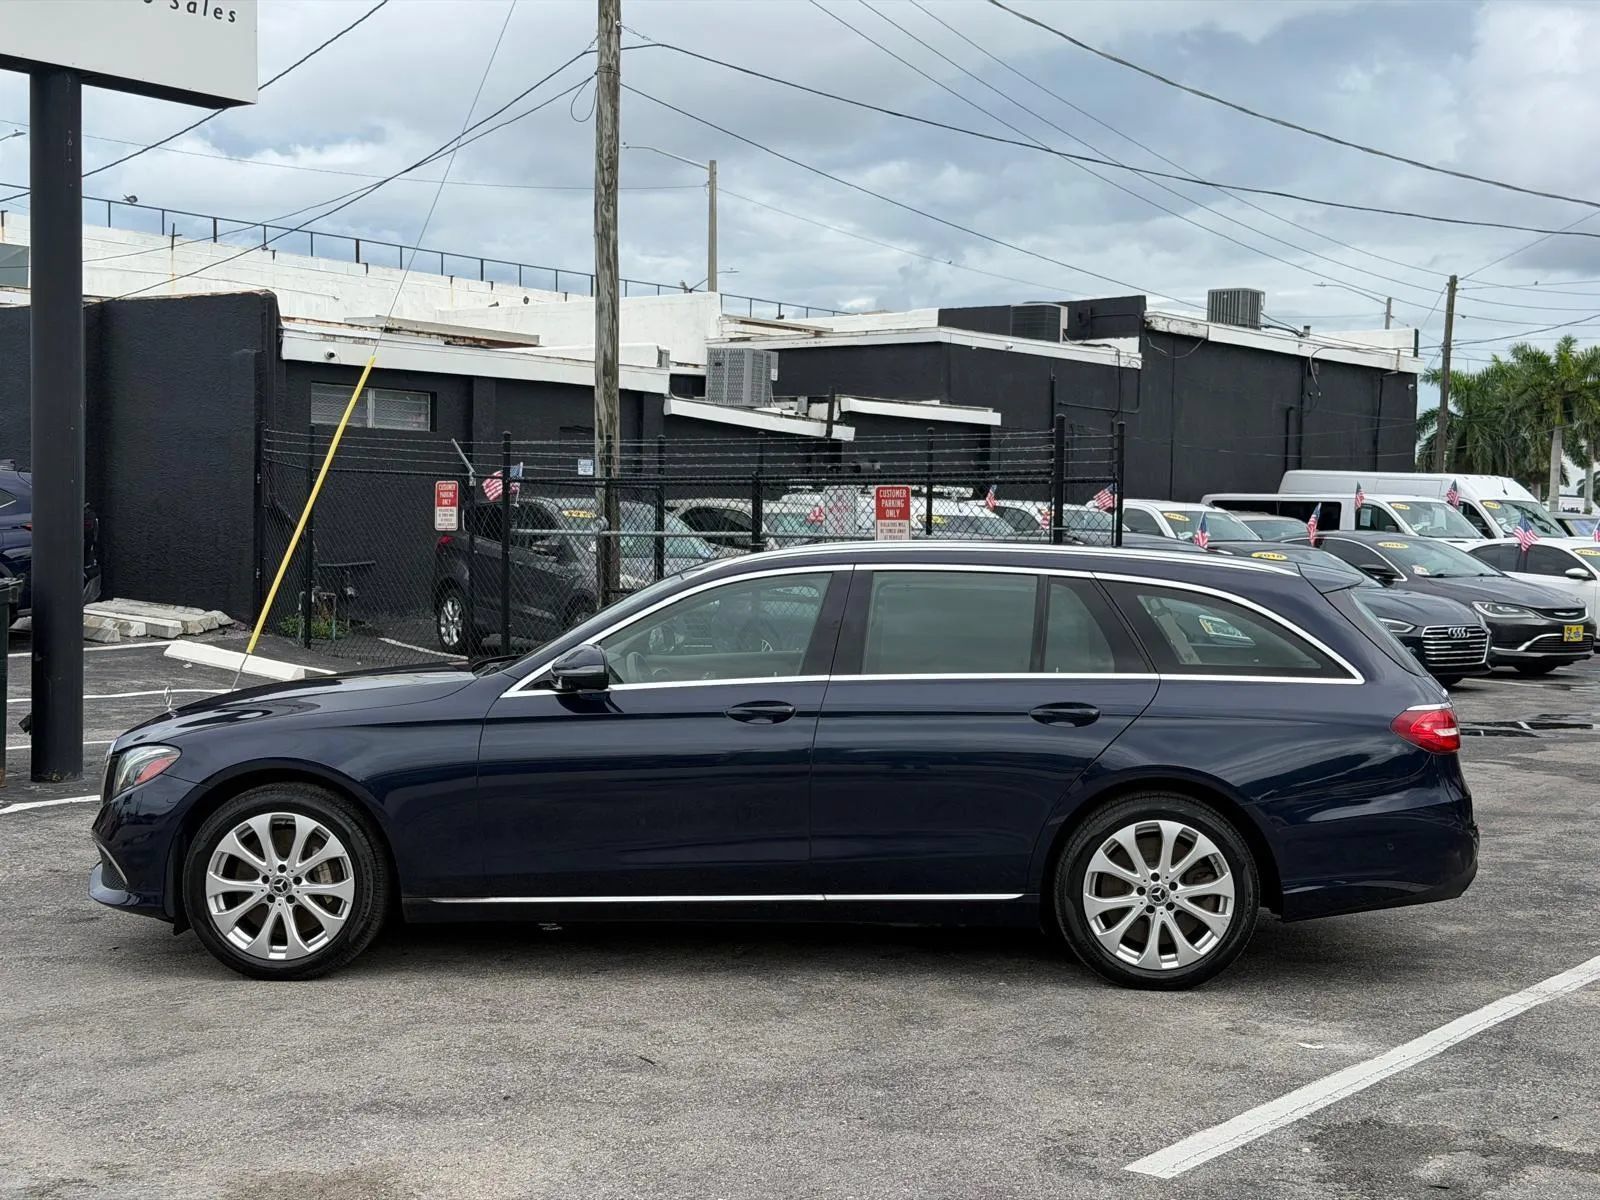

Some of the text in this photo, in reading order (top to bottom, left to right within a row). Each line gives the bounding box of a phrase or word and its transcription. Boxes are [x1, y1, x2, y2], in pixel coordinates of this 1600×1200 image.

[879, 489, 907, 498] CUSTOMER
[881, 499, 905, 508] PARKING
[885, 509, 900, 518] ONLY
